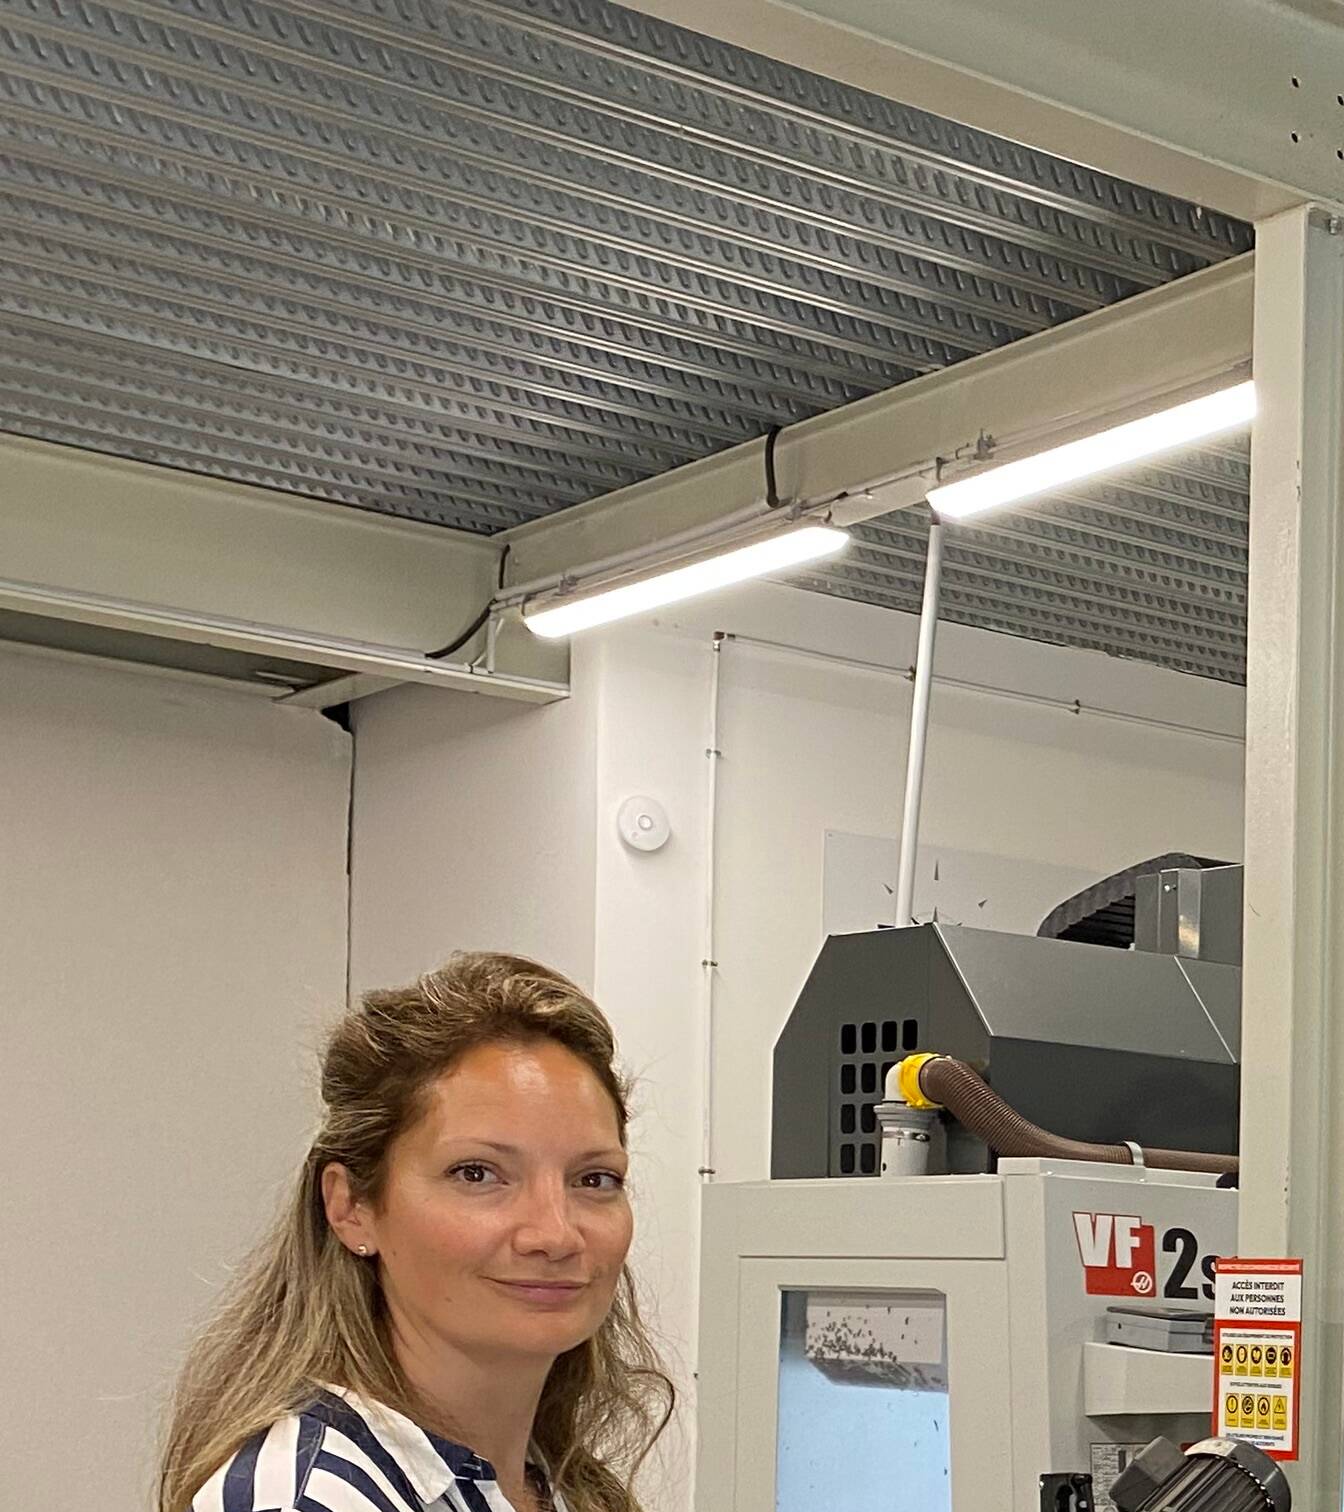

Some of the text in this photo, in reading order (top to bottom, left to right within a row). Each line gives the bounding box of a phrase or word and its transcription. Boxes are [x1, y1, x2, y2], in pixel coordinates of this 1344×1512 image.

[1072, 1211, 1142, 1269] VF
[1254, 1281, 1284, 1290] INTERDIT
[1231, 1294, 1284, 1303] AUX PERSONNES
[1245, 1306, 1286, 1316] AUTORISÉES
